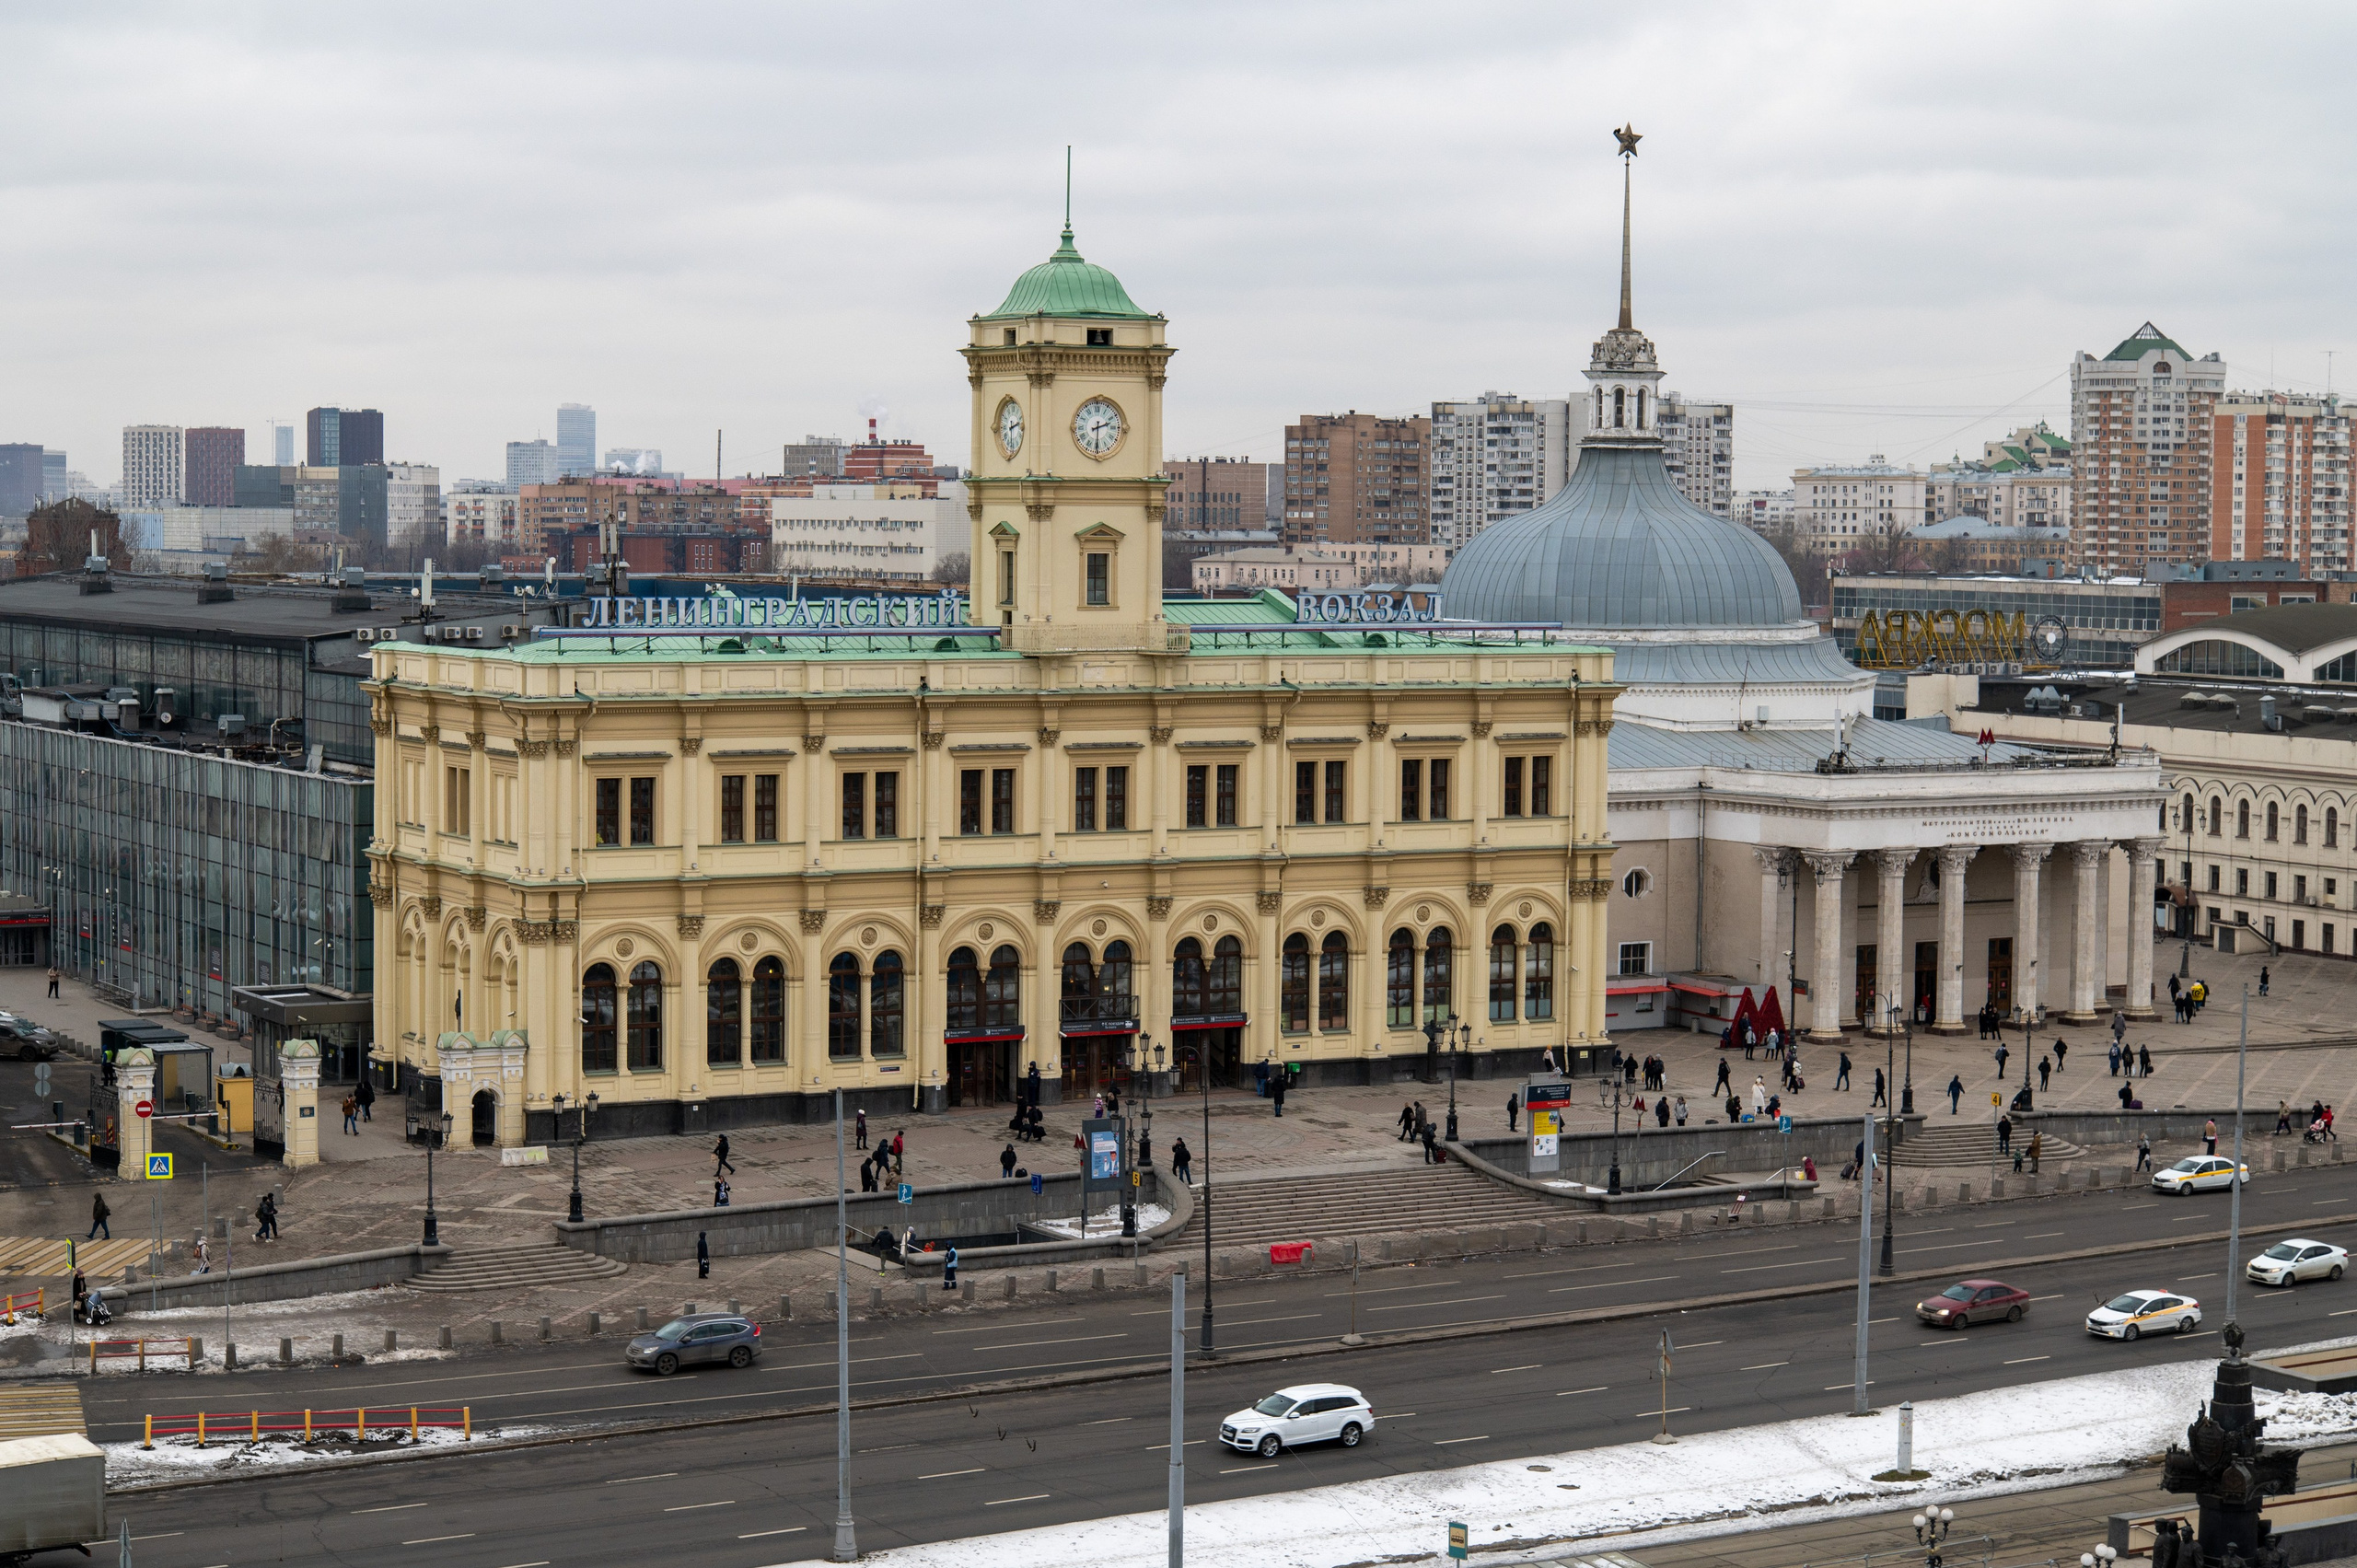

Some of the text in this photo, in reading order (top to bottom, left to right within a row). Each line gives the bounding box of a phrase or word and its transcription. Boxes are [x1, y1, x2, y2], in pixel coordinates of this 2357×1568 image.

[582, 587, 964, 632] ЛЕНИНГРАДСКИЙ
[1295, 593, 1444, 622] ВОКЗАЛ
[1992, 1095, 1997, 1104] 4
[1133, 1174, 1139, 1184] 5
